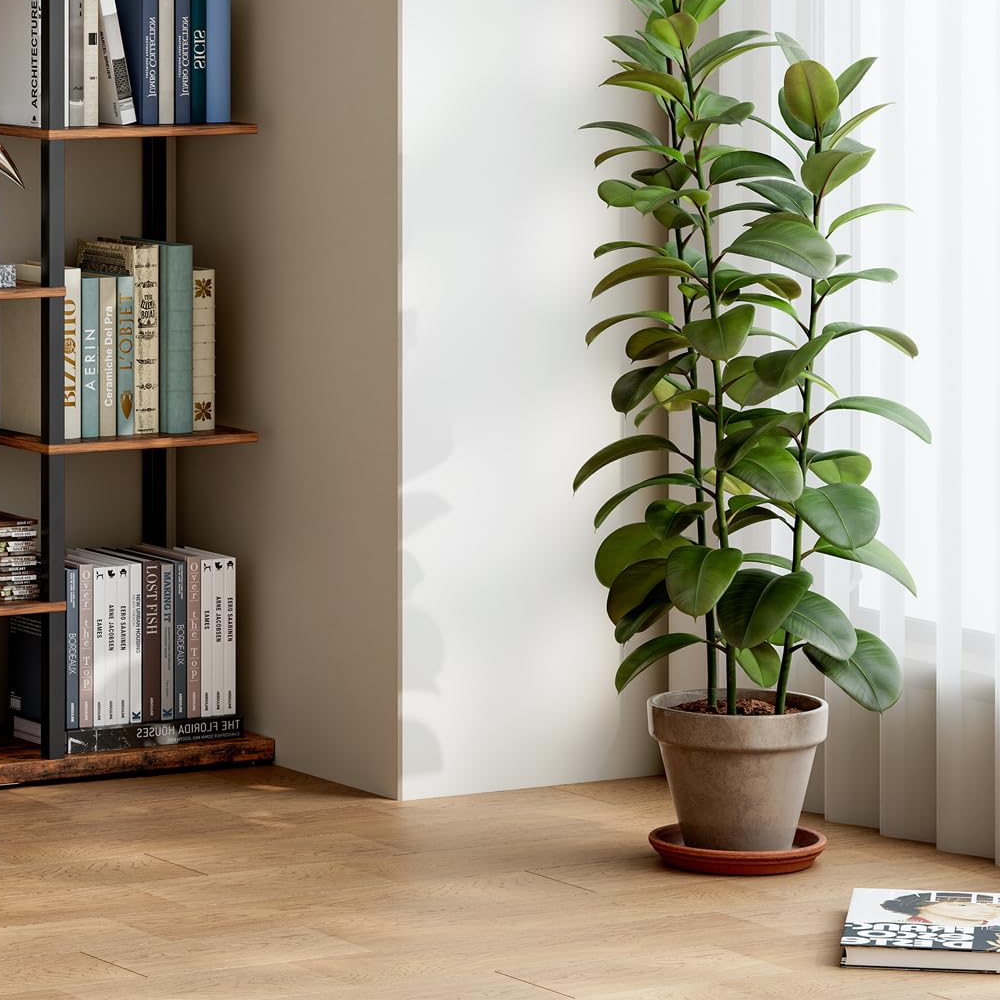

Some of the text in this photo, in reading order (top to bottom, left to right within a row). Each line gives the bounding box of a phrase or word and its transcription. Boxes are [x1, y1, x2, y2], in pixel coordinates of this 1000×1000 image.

[84, 329, 96, 391] AERIN
[119, 294, 134, 370] L'OBJET
[104, 348, 113, 407] Ceramiche
[146, 565, 158, 635] LOST FISH
[163, 571, 171, 612] MAKING
[163, 613, 171, 622] IT
[68, 632, 77, 675] BORDEAUX
[83, 569, 91, 689] Over the Top
[176, 624, 184, 665] BORDEAUX
